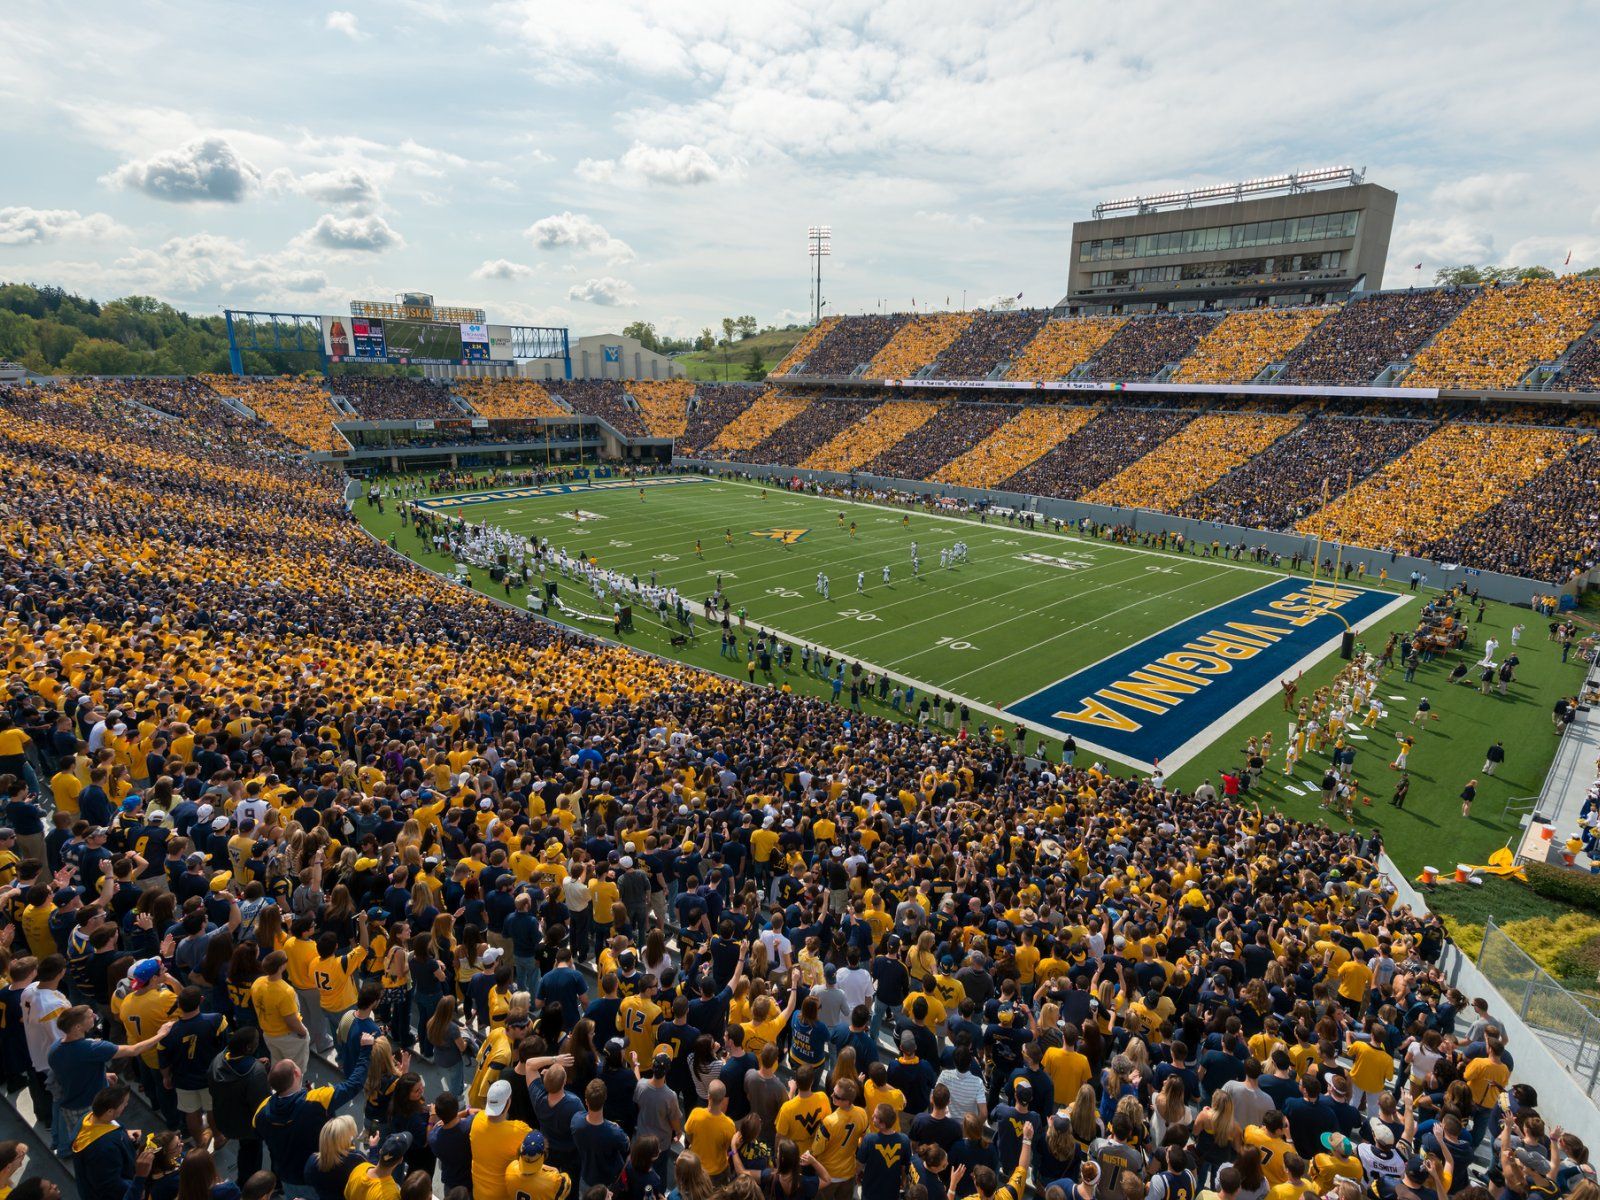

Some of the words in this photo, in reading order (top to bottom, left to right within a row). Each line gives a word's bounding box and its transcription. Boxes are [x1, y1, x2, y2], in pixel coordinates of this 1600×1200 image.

[837, 608, 877, 621] 20
[1252, 583, 1366, 626] WEST
[934, 636, 972, 650] 10
[1051, 621, 1294, 732] VIRGINIA
[314, 970, 333, 990] 12
[129, 1015, 142, 1036] 7
[625, 1007, 647, 1033] 12
[182, 1034, 198, 1059] 7
[1260, 1145, 1274, 1165] 7
